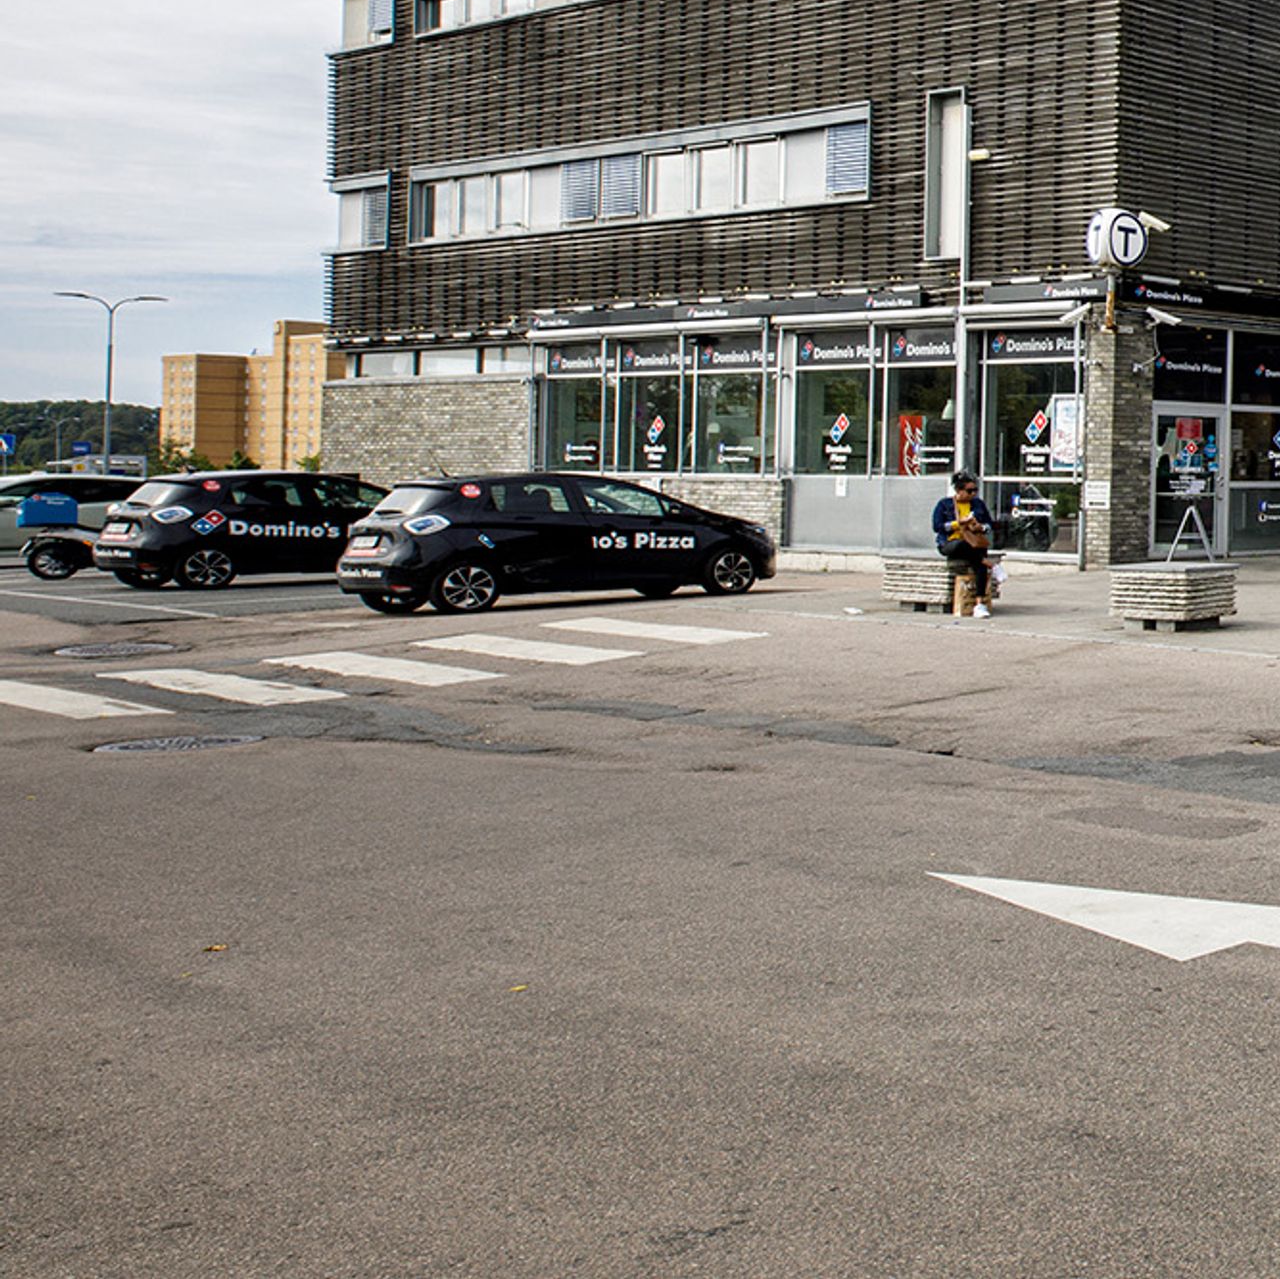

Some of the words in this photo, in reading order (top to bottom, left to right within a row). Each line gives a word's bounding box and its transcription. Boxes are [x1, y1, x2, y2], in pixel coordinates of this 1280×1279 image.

[1116, 225, 1138, 258] T
[1006, 337, 1054, 352] Domino's
[228, 520, 340, 538] Domino's
[634, 532, 695, 549] Pizza
